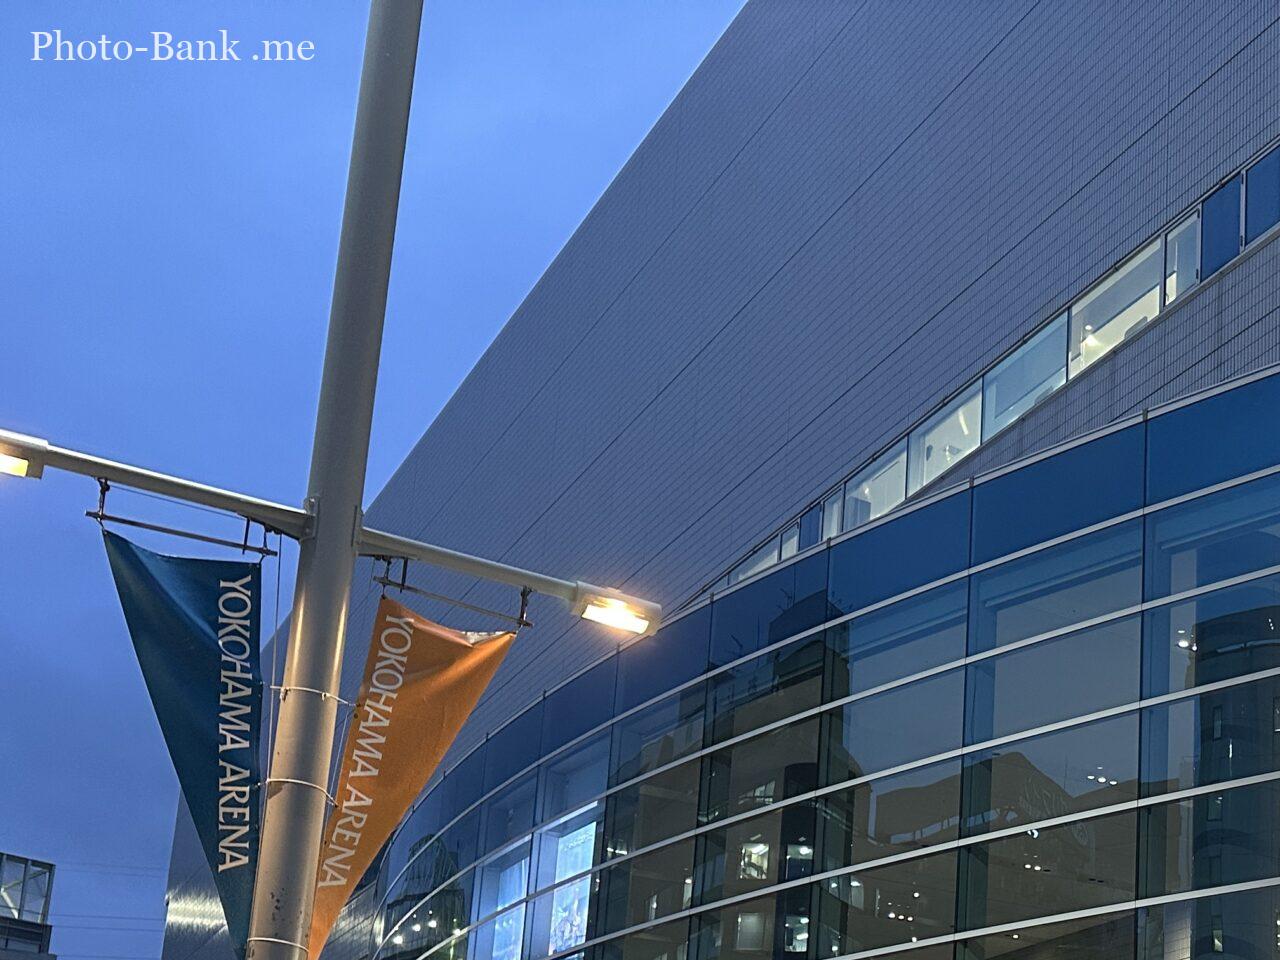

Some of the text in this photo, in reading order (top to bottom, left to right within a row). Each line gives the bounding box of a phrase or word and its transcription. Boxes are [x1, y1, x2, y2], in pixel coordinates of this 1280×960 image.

[217, 574, 253, 873] YOKOHAMA ARENA
[317, 615, 414, 889] YOKOHAMA ARENA
